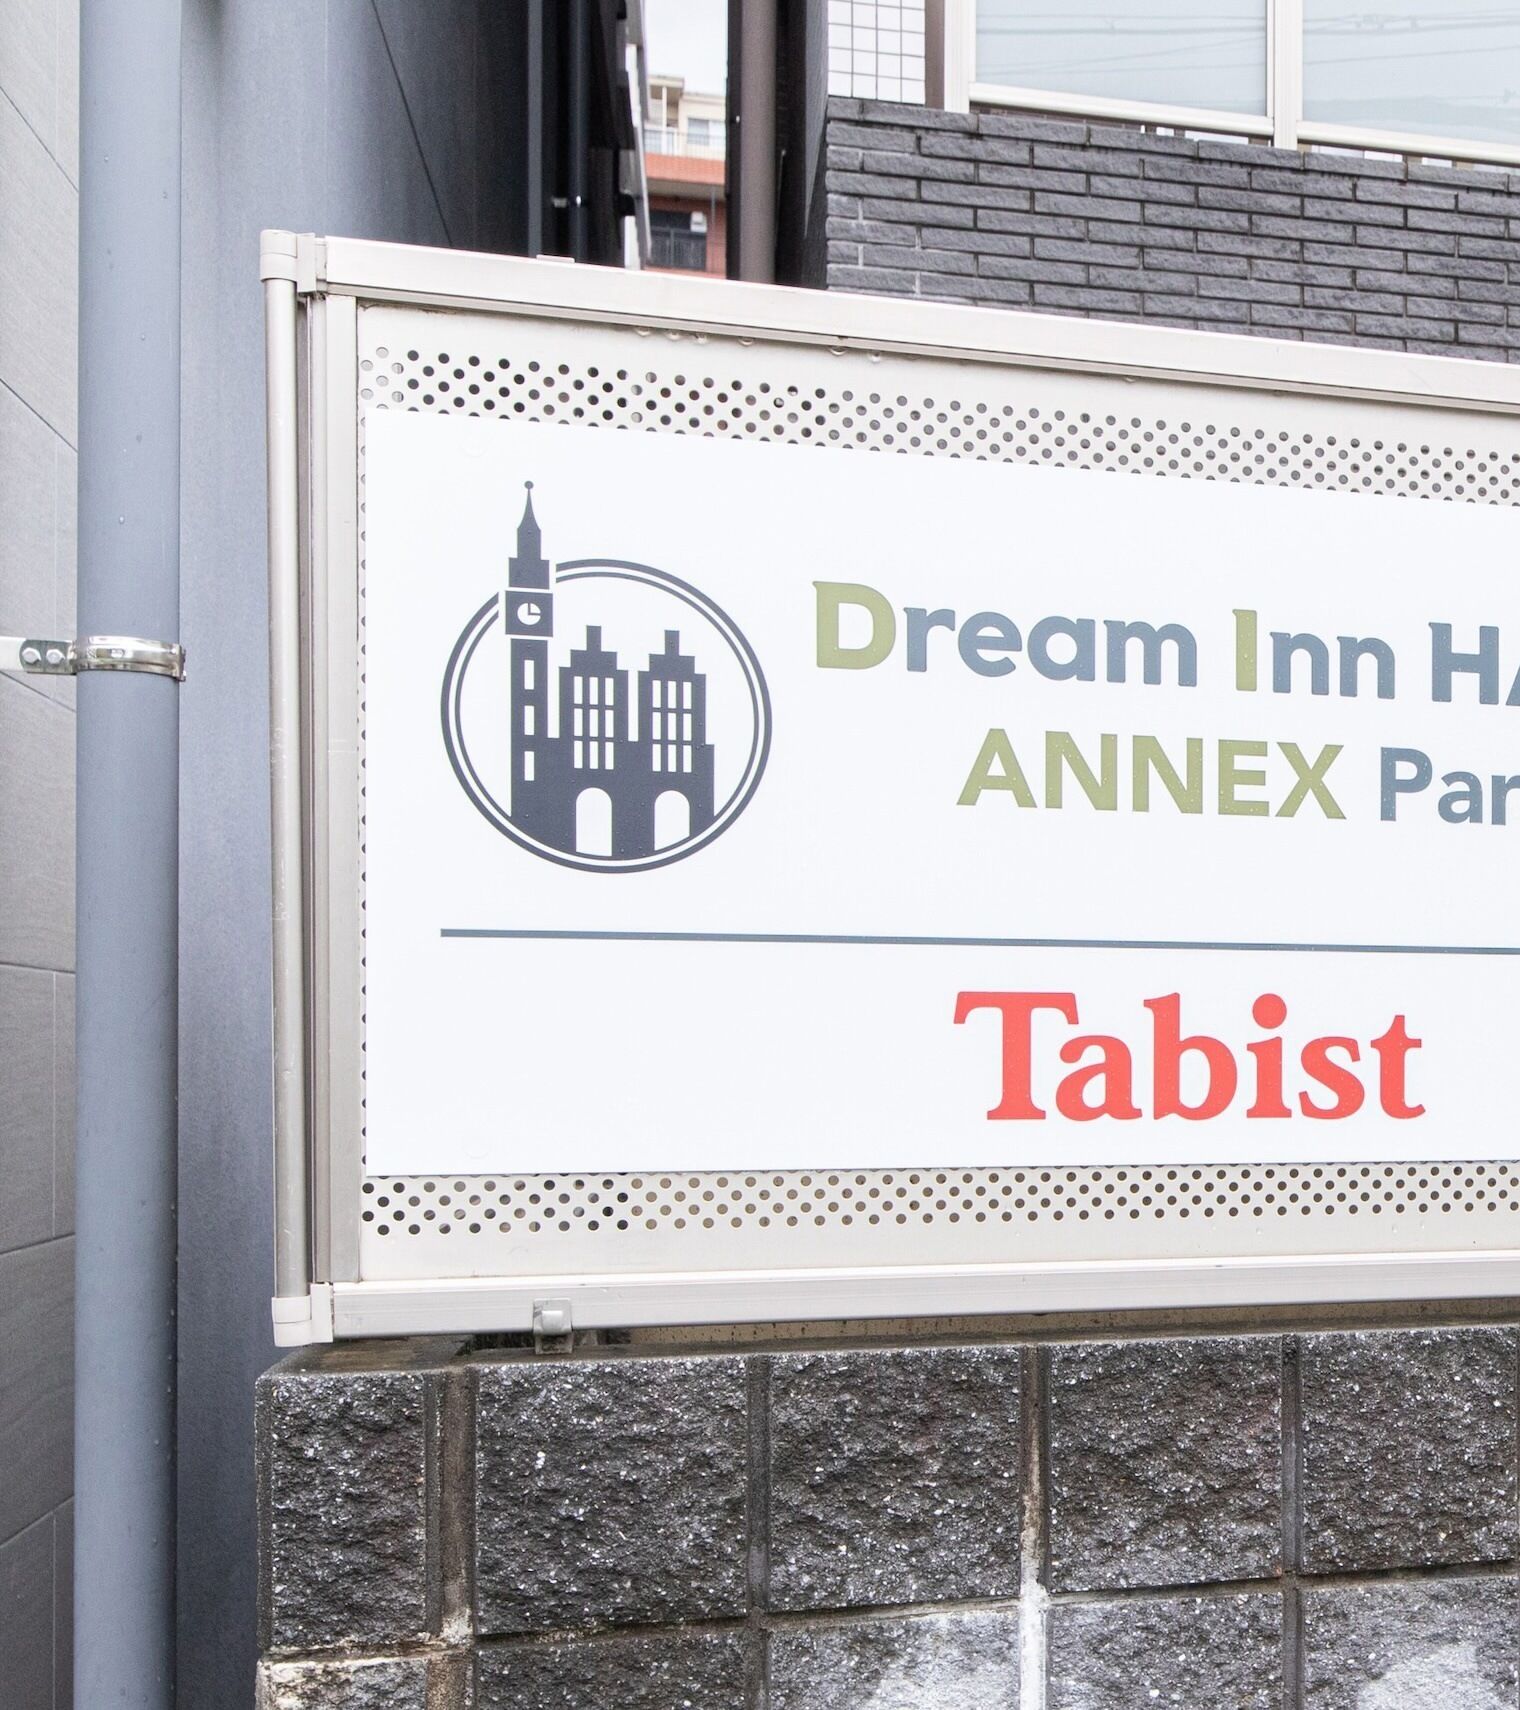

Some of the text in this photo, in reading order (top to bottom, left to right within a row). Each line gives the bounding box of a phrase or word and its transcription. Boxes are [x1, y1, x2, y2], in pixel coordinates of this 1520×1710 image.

[812, 581, 1197, 687] Dream
[1232, 609, 1395, 699] Inn
[957, 728, 1346, 820] ANNEX
[953, 991, 1426, 1122] Tabist
